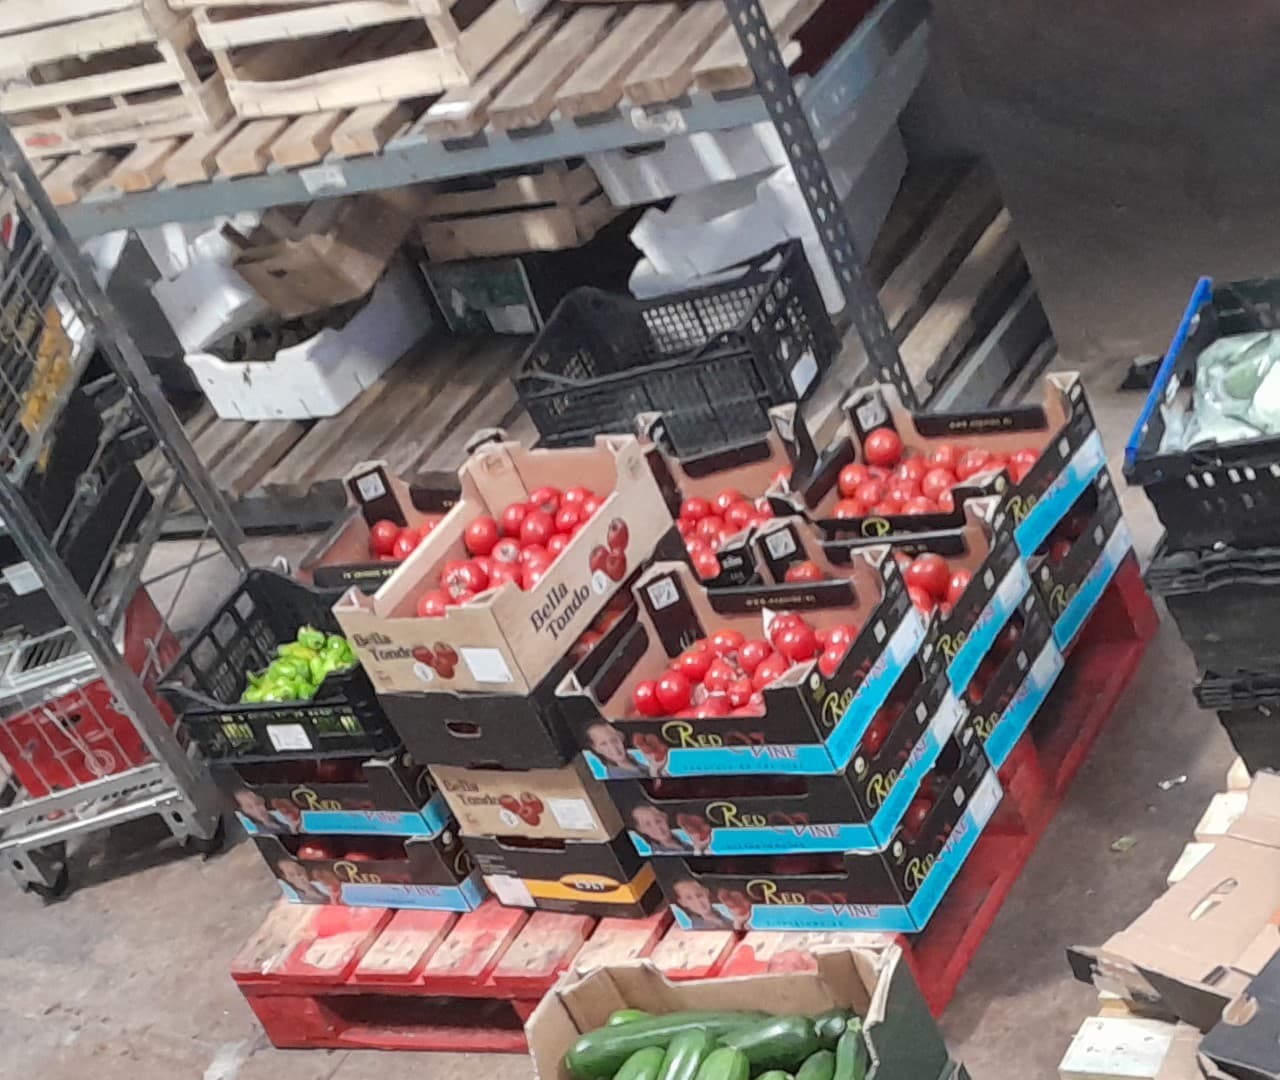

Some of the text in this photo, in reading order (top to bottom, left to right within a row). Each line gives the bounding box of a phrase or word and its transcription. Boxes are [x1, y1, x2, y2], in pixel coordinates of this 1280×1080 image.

[529, 582, 569, 633] Bella
[544, 584, 591, 641] Tondo
[662, 721, 722, 748] RED
[705, 801, 766, 827] RED
[746, 879, 805, 905] RED
